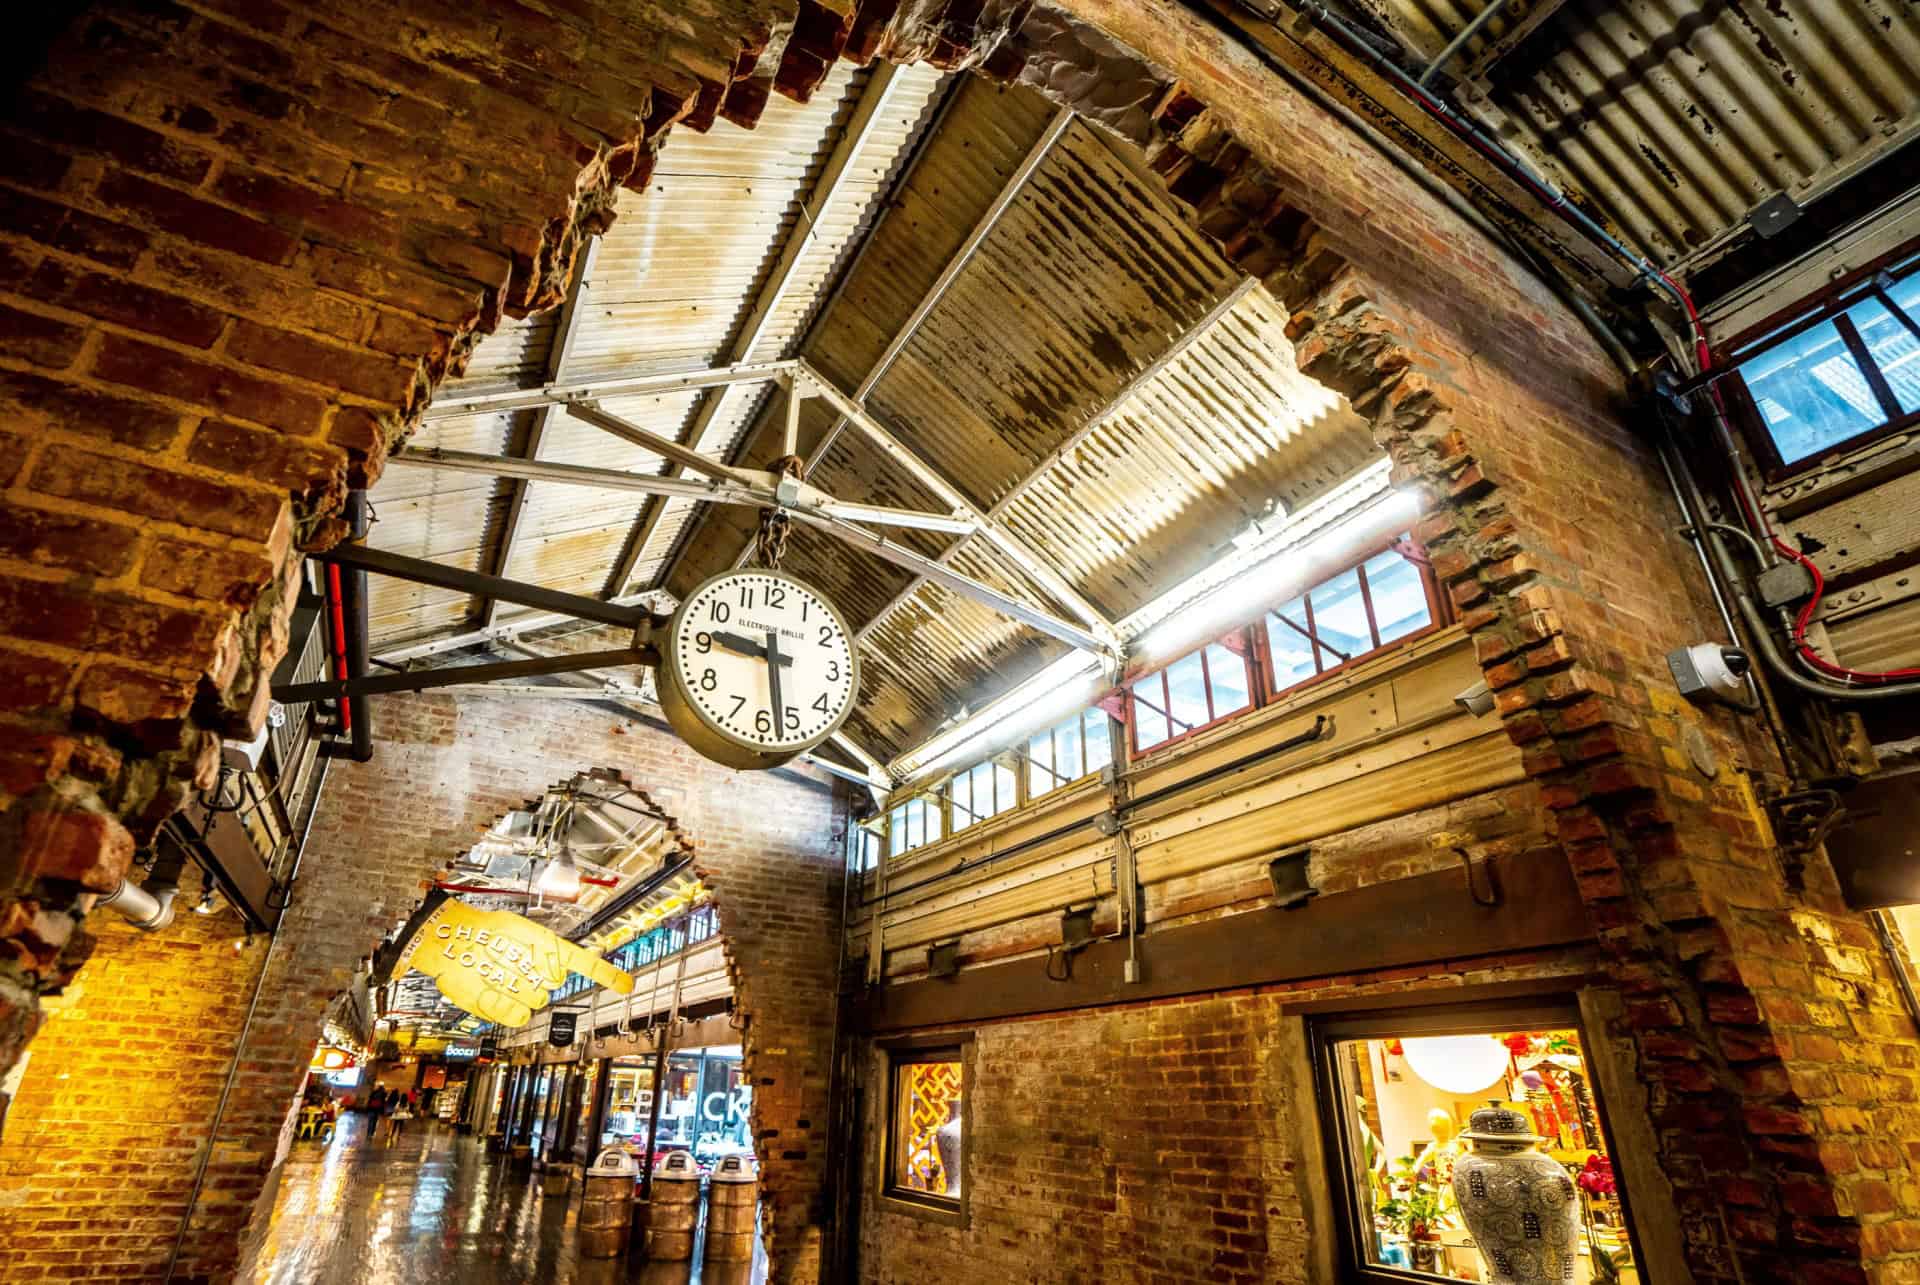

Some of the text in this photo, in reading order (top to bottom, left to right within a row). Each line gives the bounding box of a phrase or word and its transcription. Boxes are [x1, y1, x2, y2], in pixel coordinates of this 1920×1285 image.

[740, 586, 753, 609] 11
[764, 585, 786, 610] 12
[710, 600, 730, 623] 10
[802, 601, 808, 622] 1
[738, 618, 777, 633] ELECTRIQUE
[818, 626, 833, 648] 2
[695, 631, 712, 654] 9
[700, 668, 717, 691] 8
[825, 660, 840, 682] 3
[729, 695, 747, 718] 7
[811, 692, 830, 715] 4
[754, 710, 771, 733] 6
[785, 706, 801, 730] 5
[403, 928, 425, 958] SHOP
[435, 923, 545, 990] CHELSEA
[442, 943, 520, 993] LOCAL
